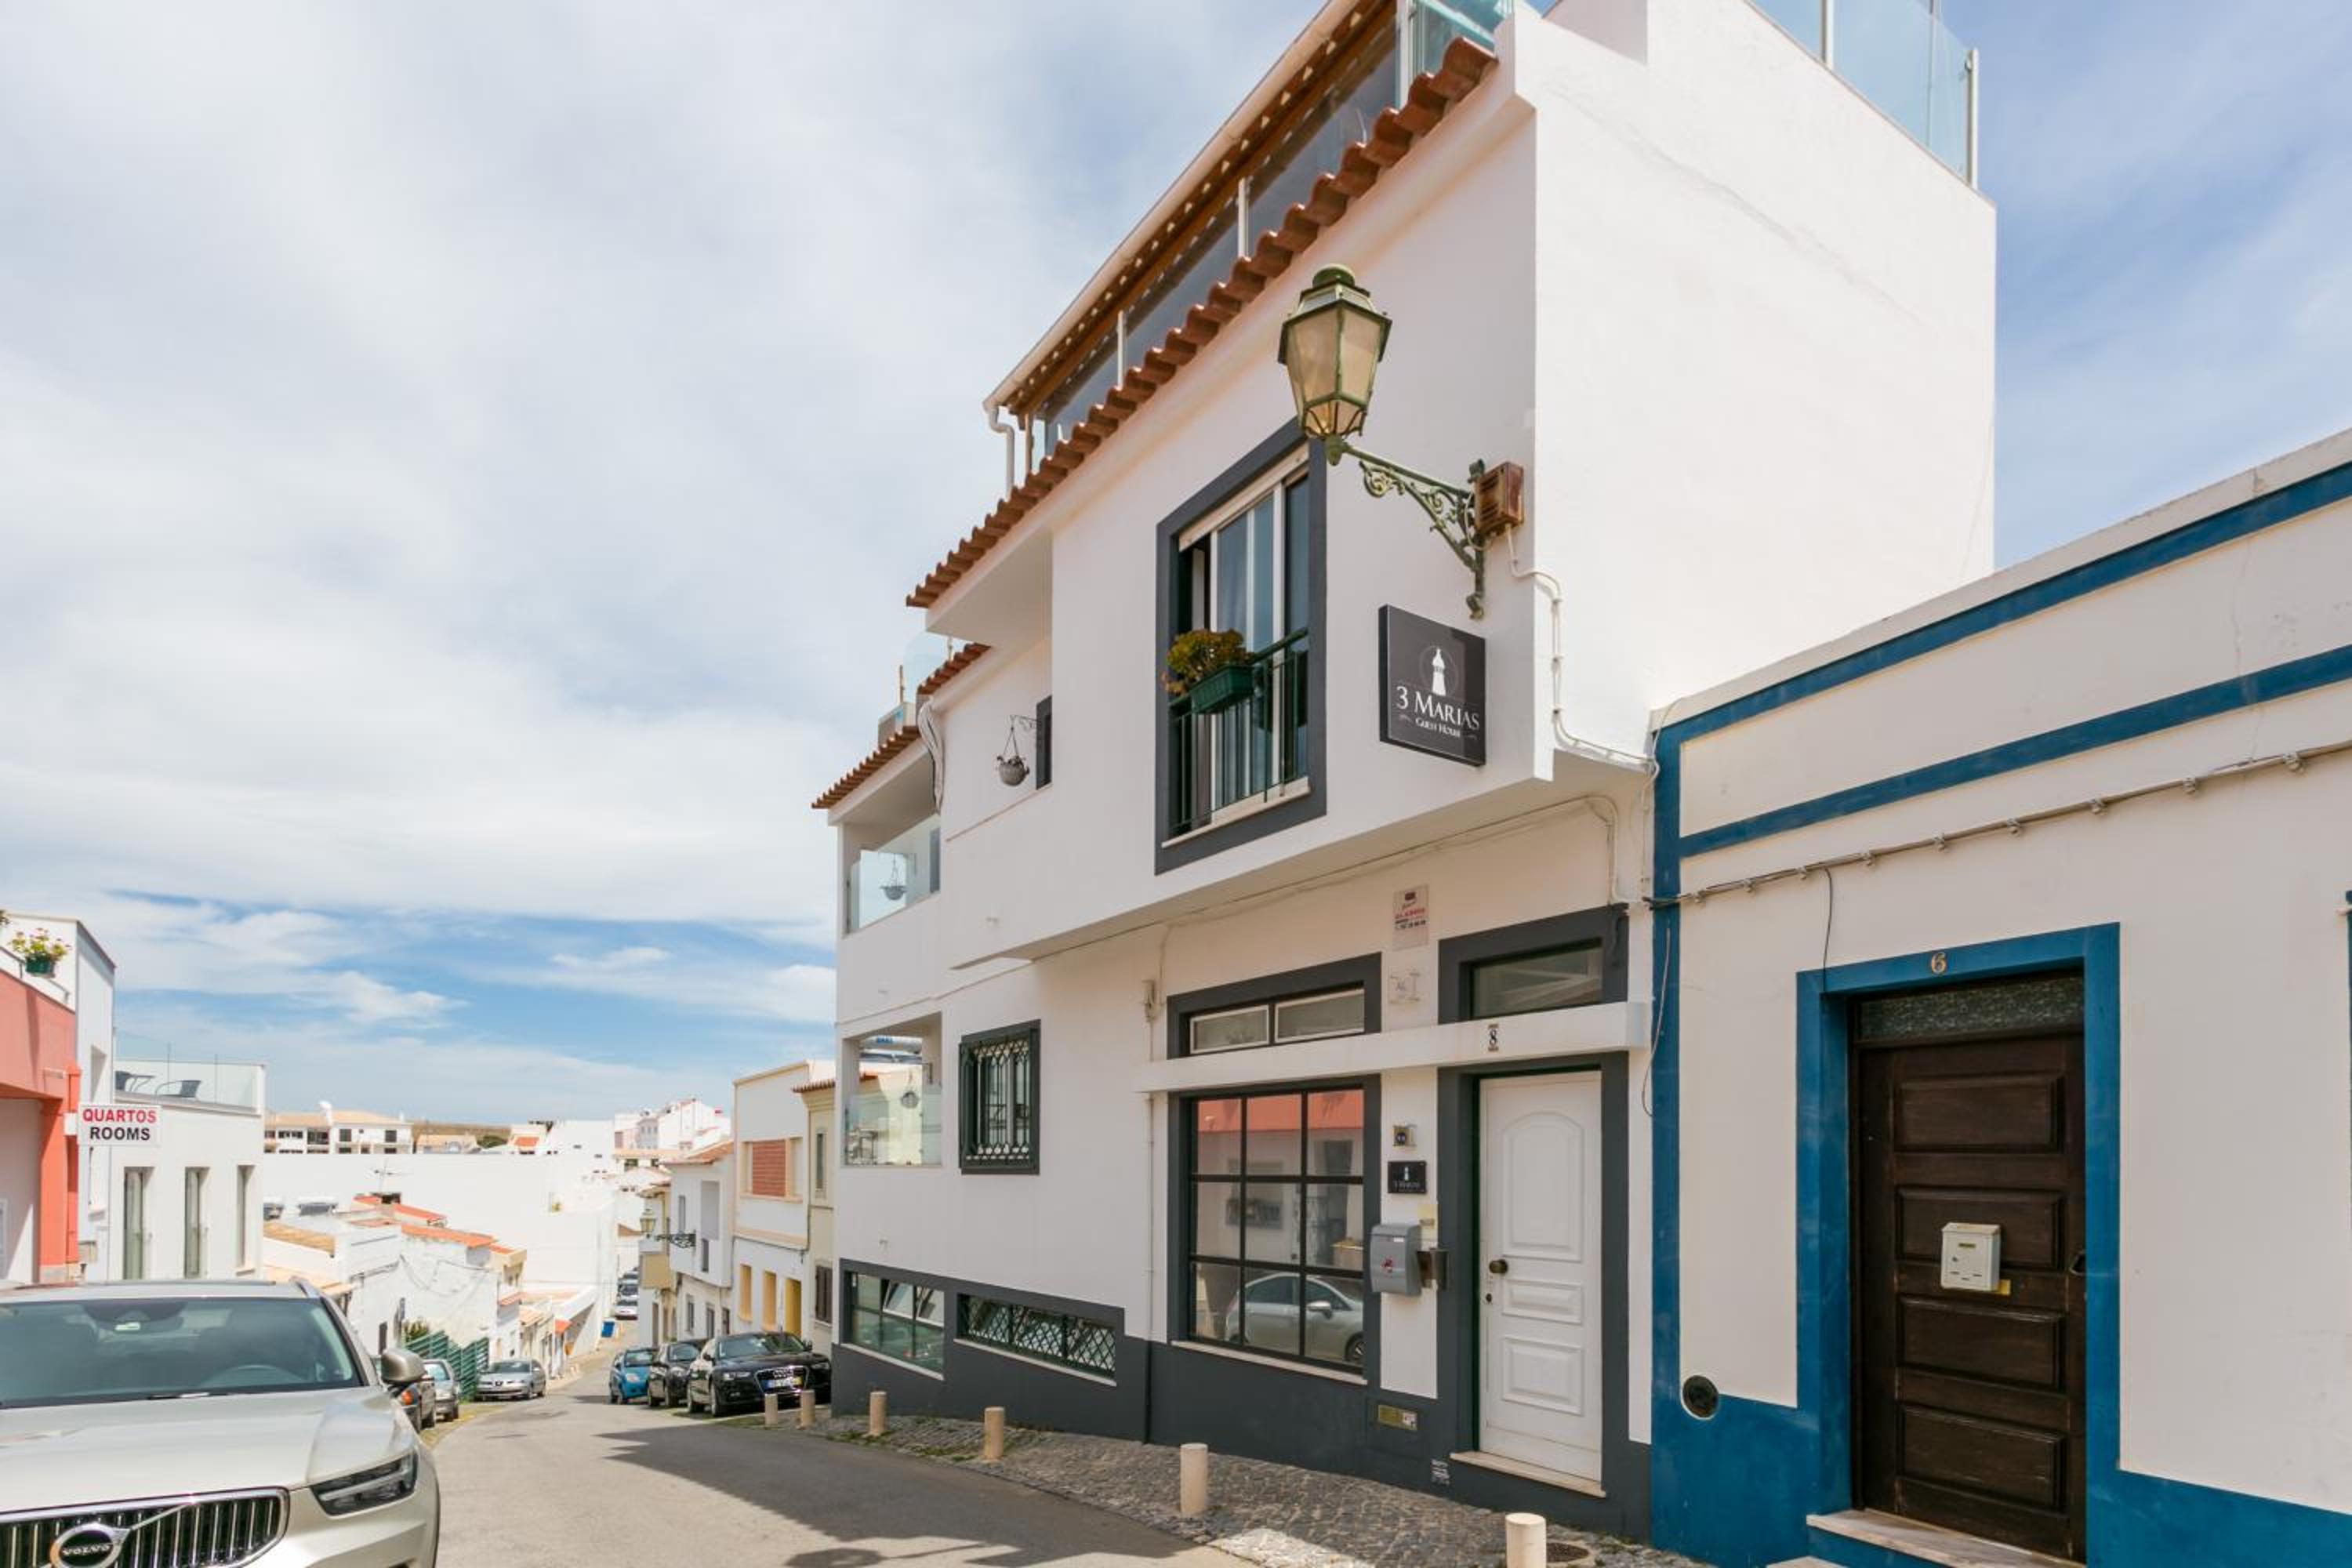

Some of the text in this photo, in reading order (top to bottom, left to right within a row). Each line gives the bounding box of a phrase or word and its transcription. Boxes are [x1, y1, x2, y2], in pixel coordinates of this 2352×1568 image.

[1396, 685, 1479, 731] 3 MARIAS
[1931, 952, 1947, 975] 6
[1489, 1029, 1497, 1047] 8
[82, 1108, 157, 1123] QUARTOS
[90, 1127, 151, 1141] ROOMS
[63, 1544, 111, 1555] VOLVO
